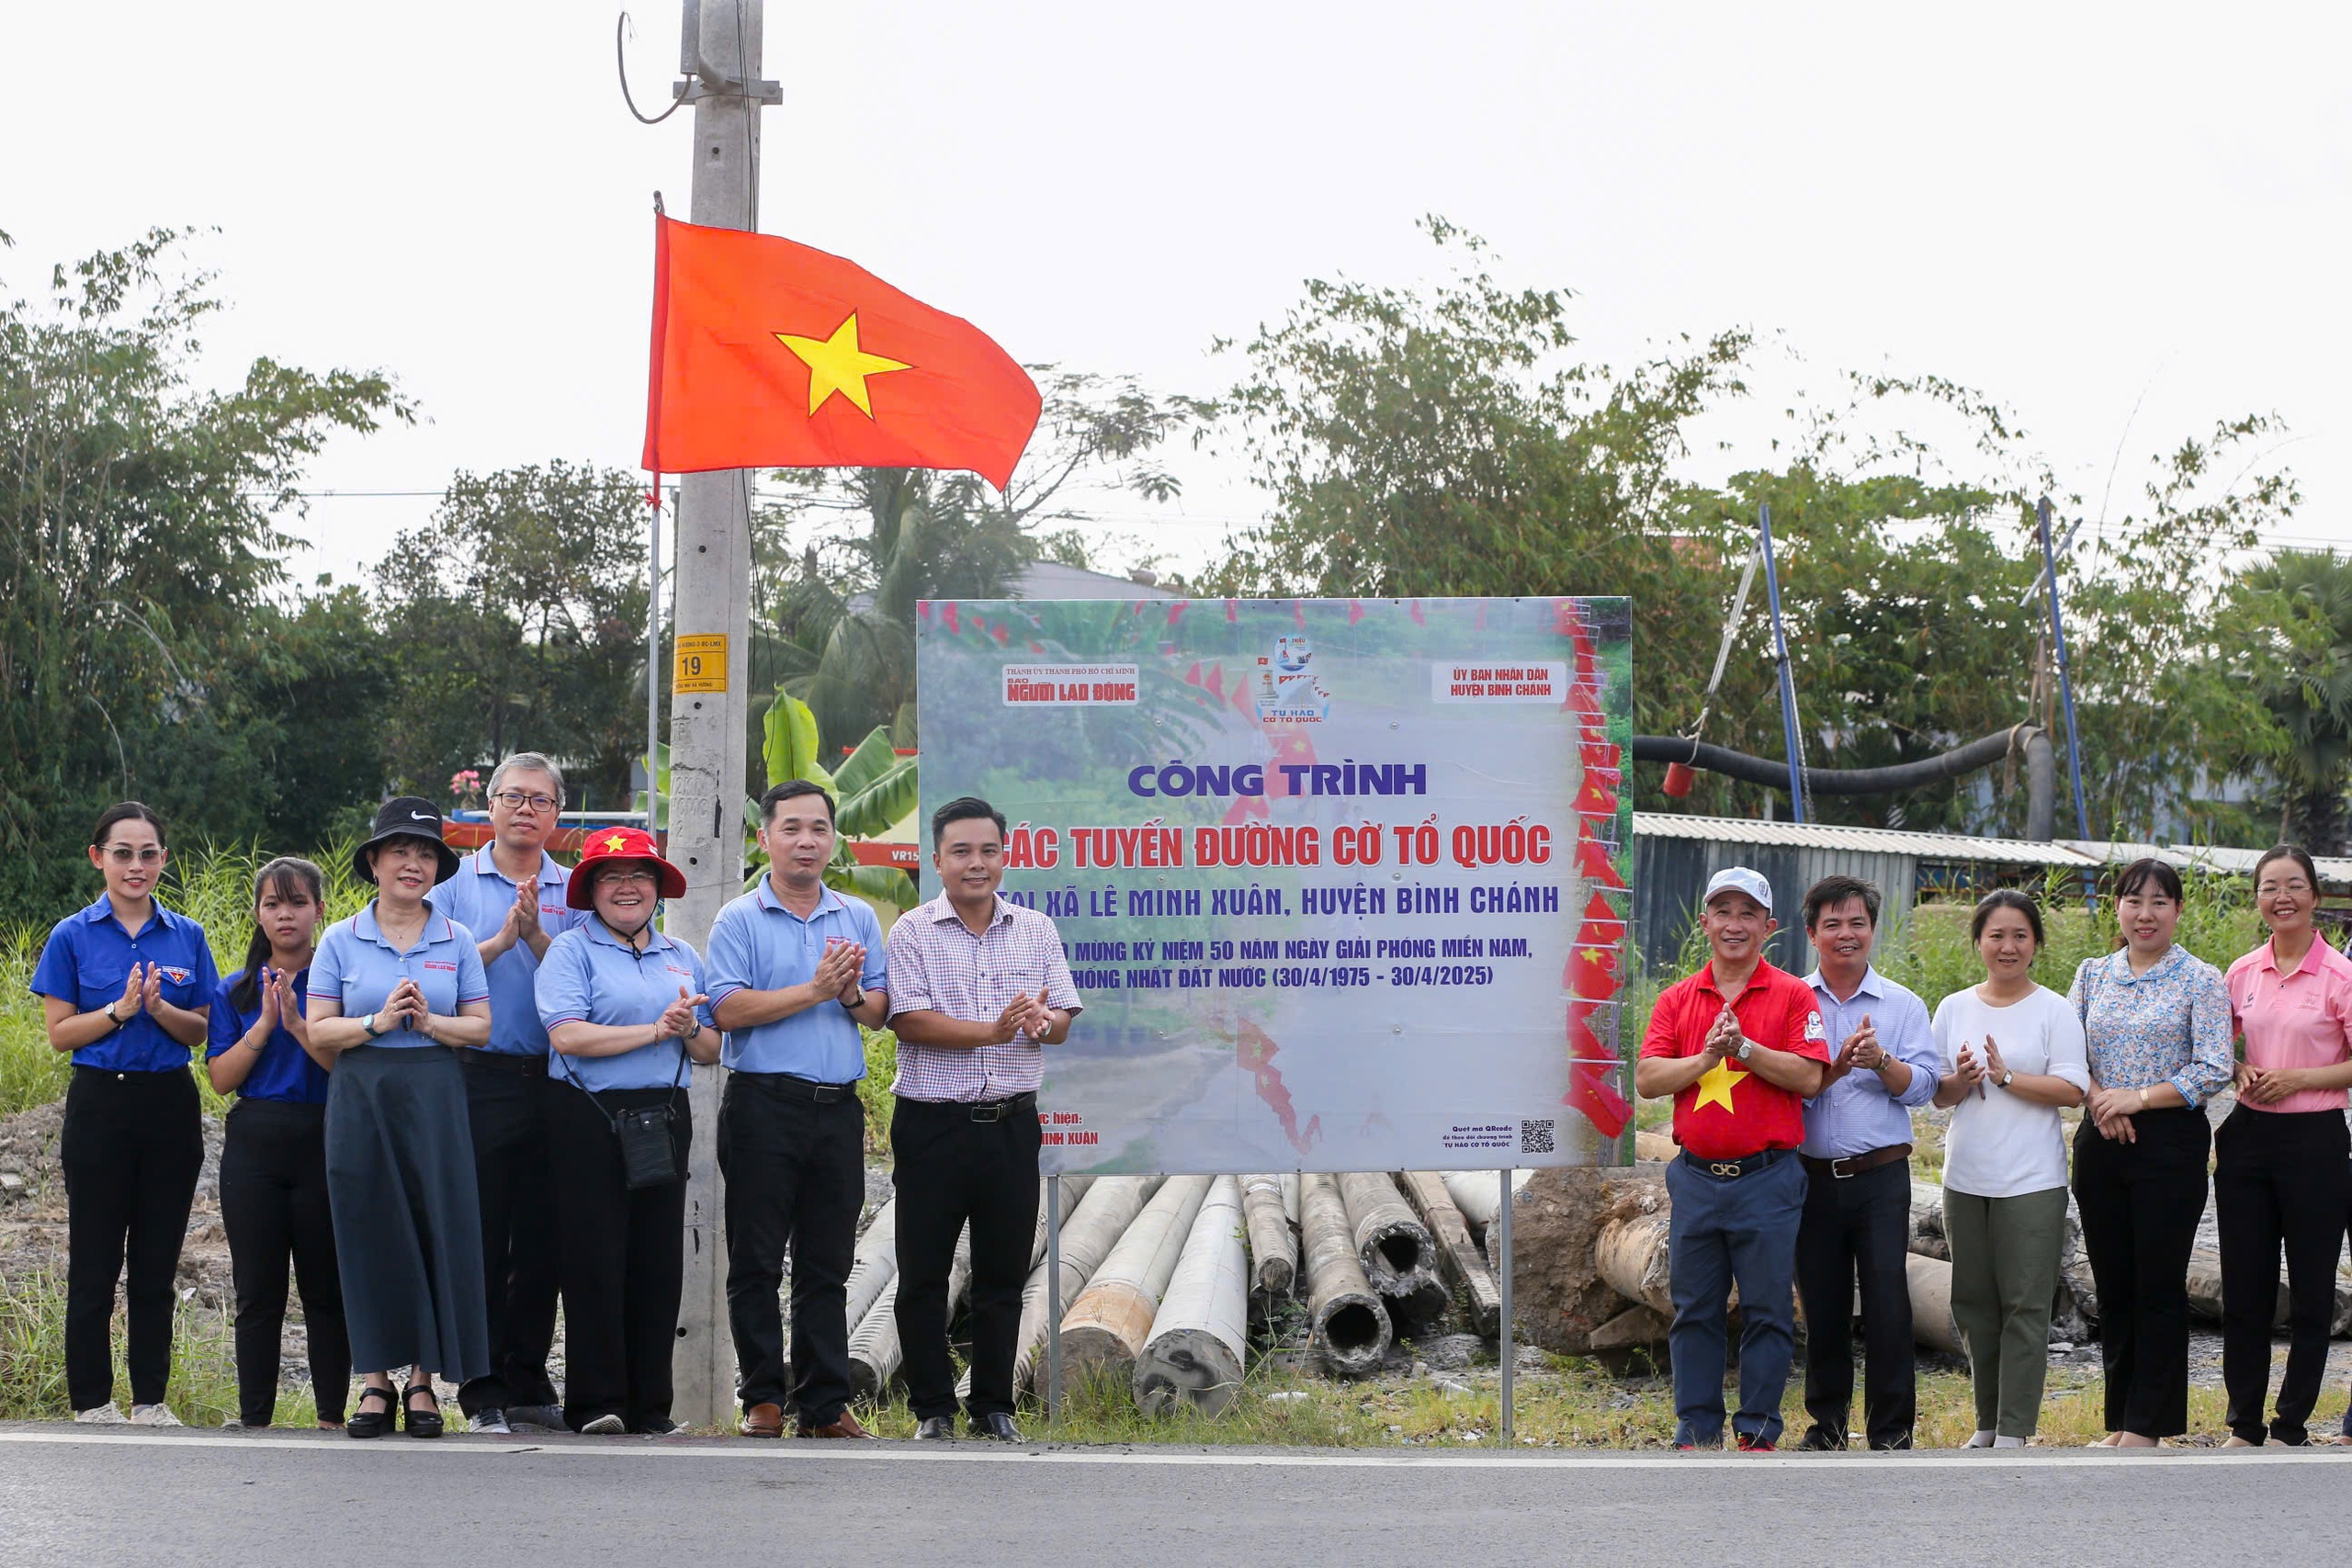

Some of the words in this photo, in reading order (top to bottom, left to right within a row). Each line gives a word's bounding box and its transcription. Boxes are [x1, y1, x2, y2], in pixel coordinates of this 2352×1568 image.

[682, 656, 701, 675] 19
[1471, 669, 1492, 681] BAN
[1495, 668, 1523, 681] NHÂN
[1527, 668, 1548, 680] DÂN
[1008, 682, 1055, 701] NGƯỜI
[1059, 683, 1089, 701] LAO
[1092, 681, 1136, 702] ĐỘNG
[1451, 682, 1484, 698] HUYỆN
[1487, 682, 1512, 695] BÌNH
[1516, 682, 1551, 695] CHÁNH
[1128, 760, 1263, 796] CÔNG
[1279, 759, 1427, 795] TRÌNH
[1070, 818, 1182, 867] TUYẾN
[1194, 821, 1319, 866] ĐƯỜNG
[1333, 820, 1383, 865] CỜ
[1394, 814, 1440, 864] TỔ
[1453, 816, 1551, 868] QUỐC
[1046, 886, 1079, 917] XÃ
[1091, 885, 1117, 917] LÊ
[1129, 890, 1200, 916] MINH
[1212, 883, 1291, 917] XUÂN,
[1302, 882, 1385, 920] HUYỆN
[1396, 882, 1459, 915] BÌNH
[1471, 881, 1558, 913] CHÁNH
[1075, 939, 1126, 962] MỪNG
[1133, 937, 1155, 961] KỶ
[1162, 939, 1204, 964] NIỆM
[1210, 941, 1234, 960] 50
[1241, 938, 1278, 959] NĂM
[1285, 938, 1329, 959] NGÀY
[1336, 935, 1371, 959] GIẢI
[1377, 936, 1435, 958] PHÓNG
[1442, 934, 1483, 957] MIỀN
[1489, 939, 1532, 959] NAM,
[1127, 965, 1172, 987] NHẤT
[1179, 964, 1213, 987] ĐẤT
[1219, 965, 1266, 987] NƯỚC
[1272, 967, 1370, 987] (30/4/1975
[1391, 966, 1493, 986] 30/4/2025)
[1053, 1111, 1082, 1126] hiện:
[1068, 1130, 1098, 1145] XUÂN
